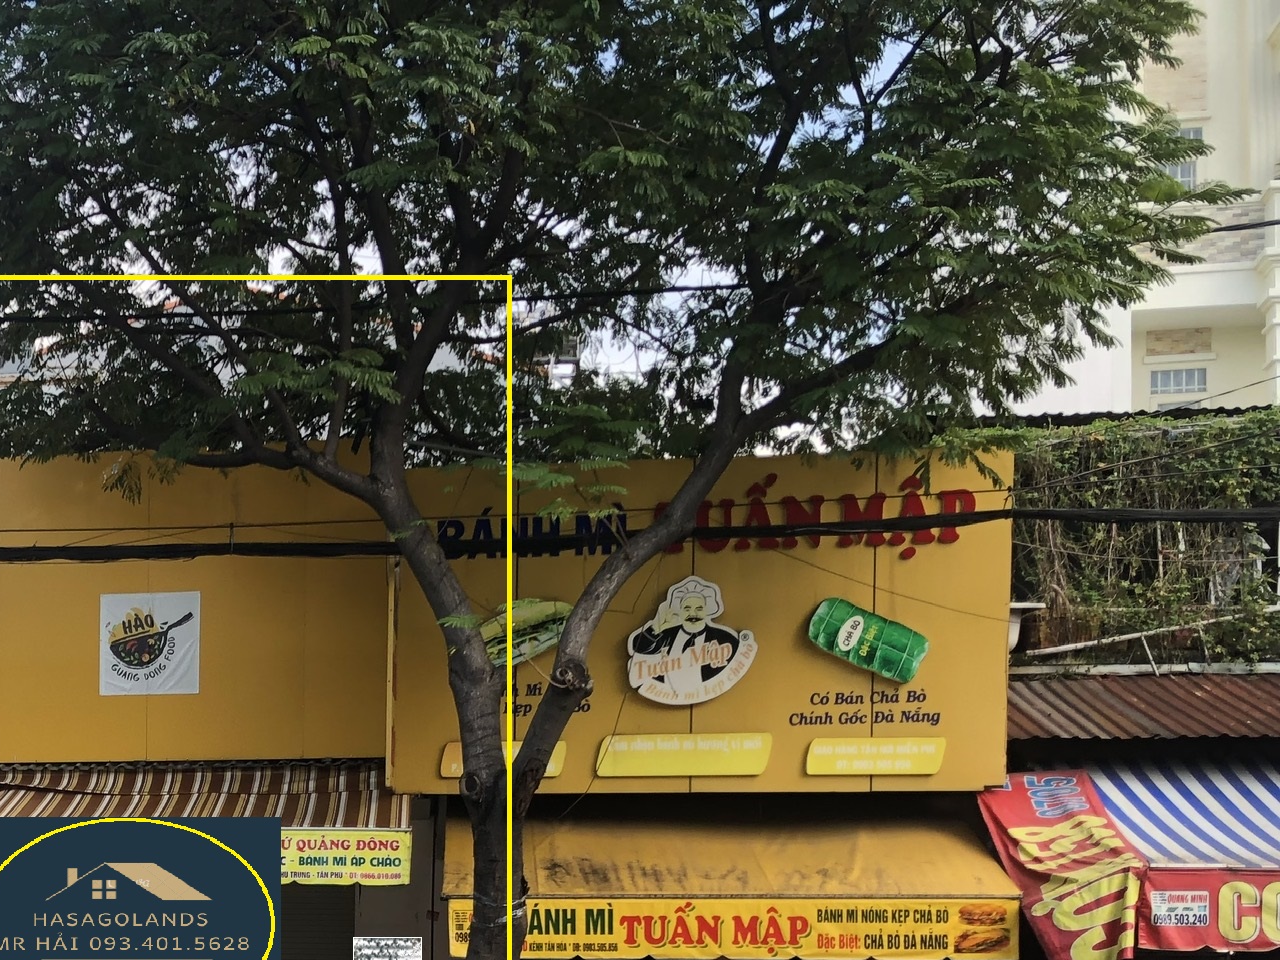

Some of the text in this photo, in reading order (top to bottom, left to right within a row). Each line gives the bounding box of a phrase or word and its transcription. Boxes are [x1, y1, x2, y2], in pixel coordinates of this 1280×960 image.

[122, 613, 155, 634] HÀO
[164, 636, 175, 661] FOOD
[810, 688, 927, 706] Có Bán Chả Bò
[789, 708, 941, 726] Chính Gốc Đà Nẵng
[296, 835, 400, 852] QUẢNG ĐÔNG
[299, 855, 329, 866] BÁNH
[817, 905, 949, 927] BÁNH MÌ NÓNG KẸP CHẢ BÒ
[1153, 913, 1207, 925] 0989.503.240
[528, 901, 810, 955] ÁNH MÌ TUẤN MẬP
[817, 928, 948, 953] Đặc Biệt: CHẢ BÒ ĐÀ NẴNG
